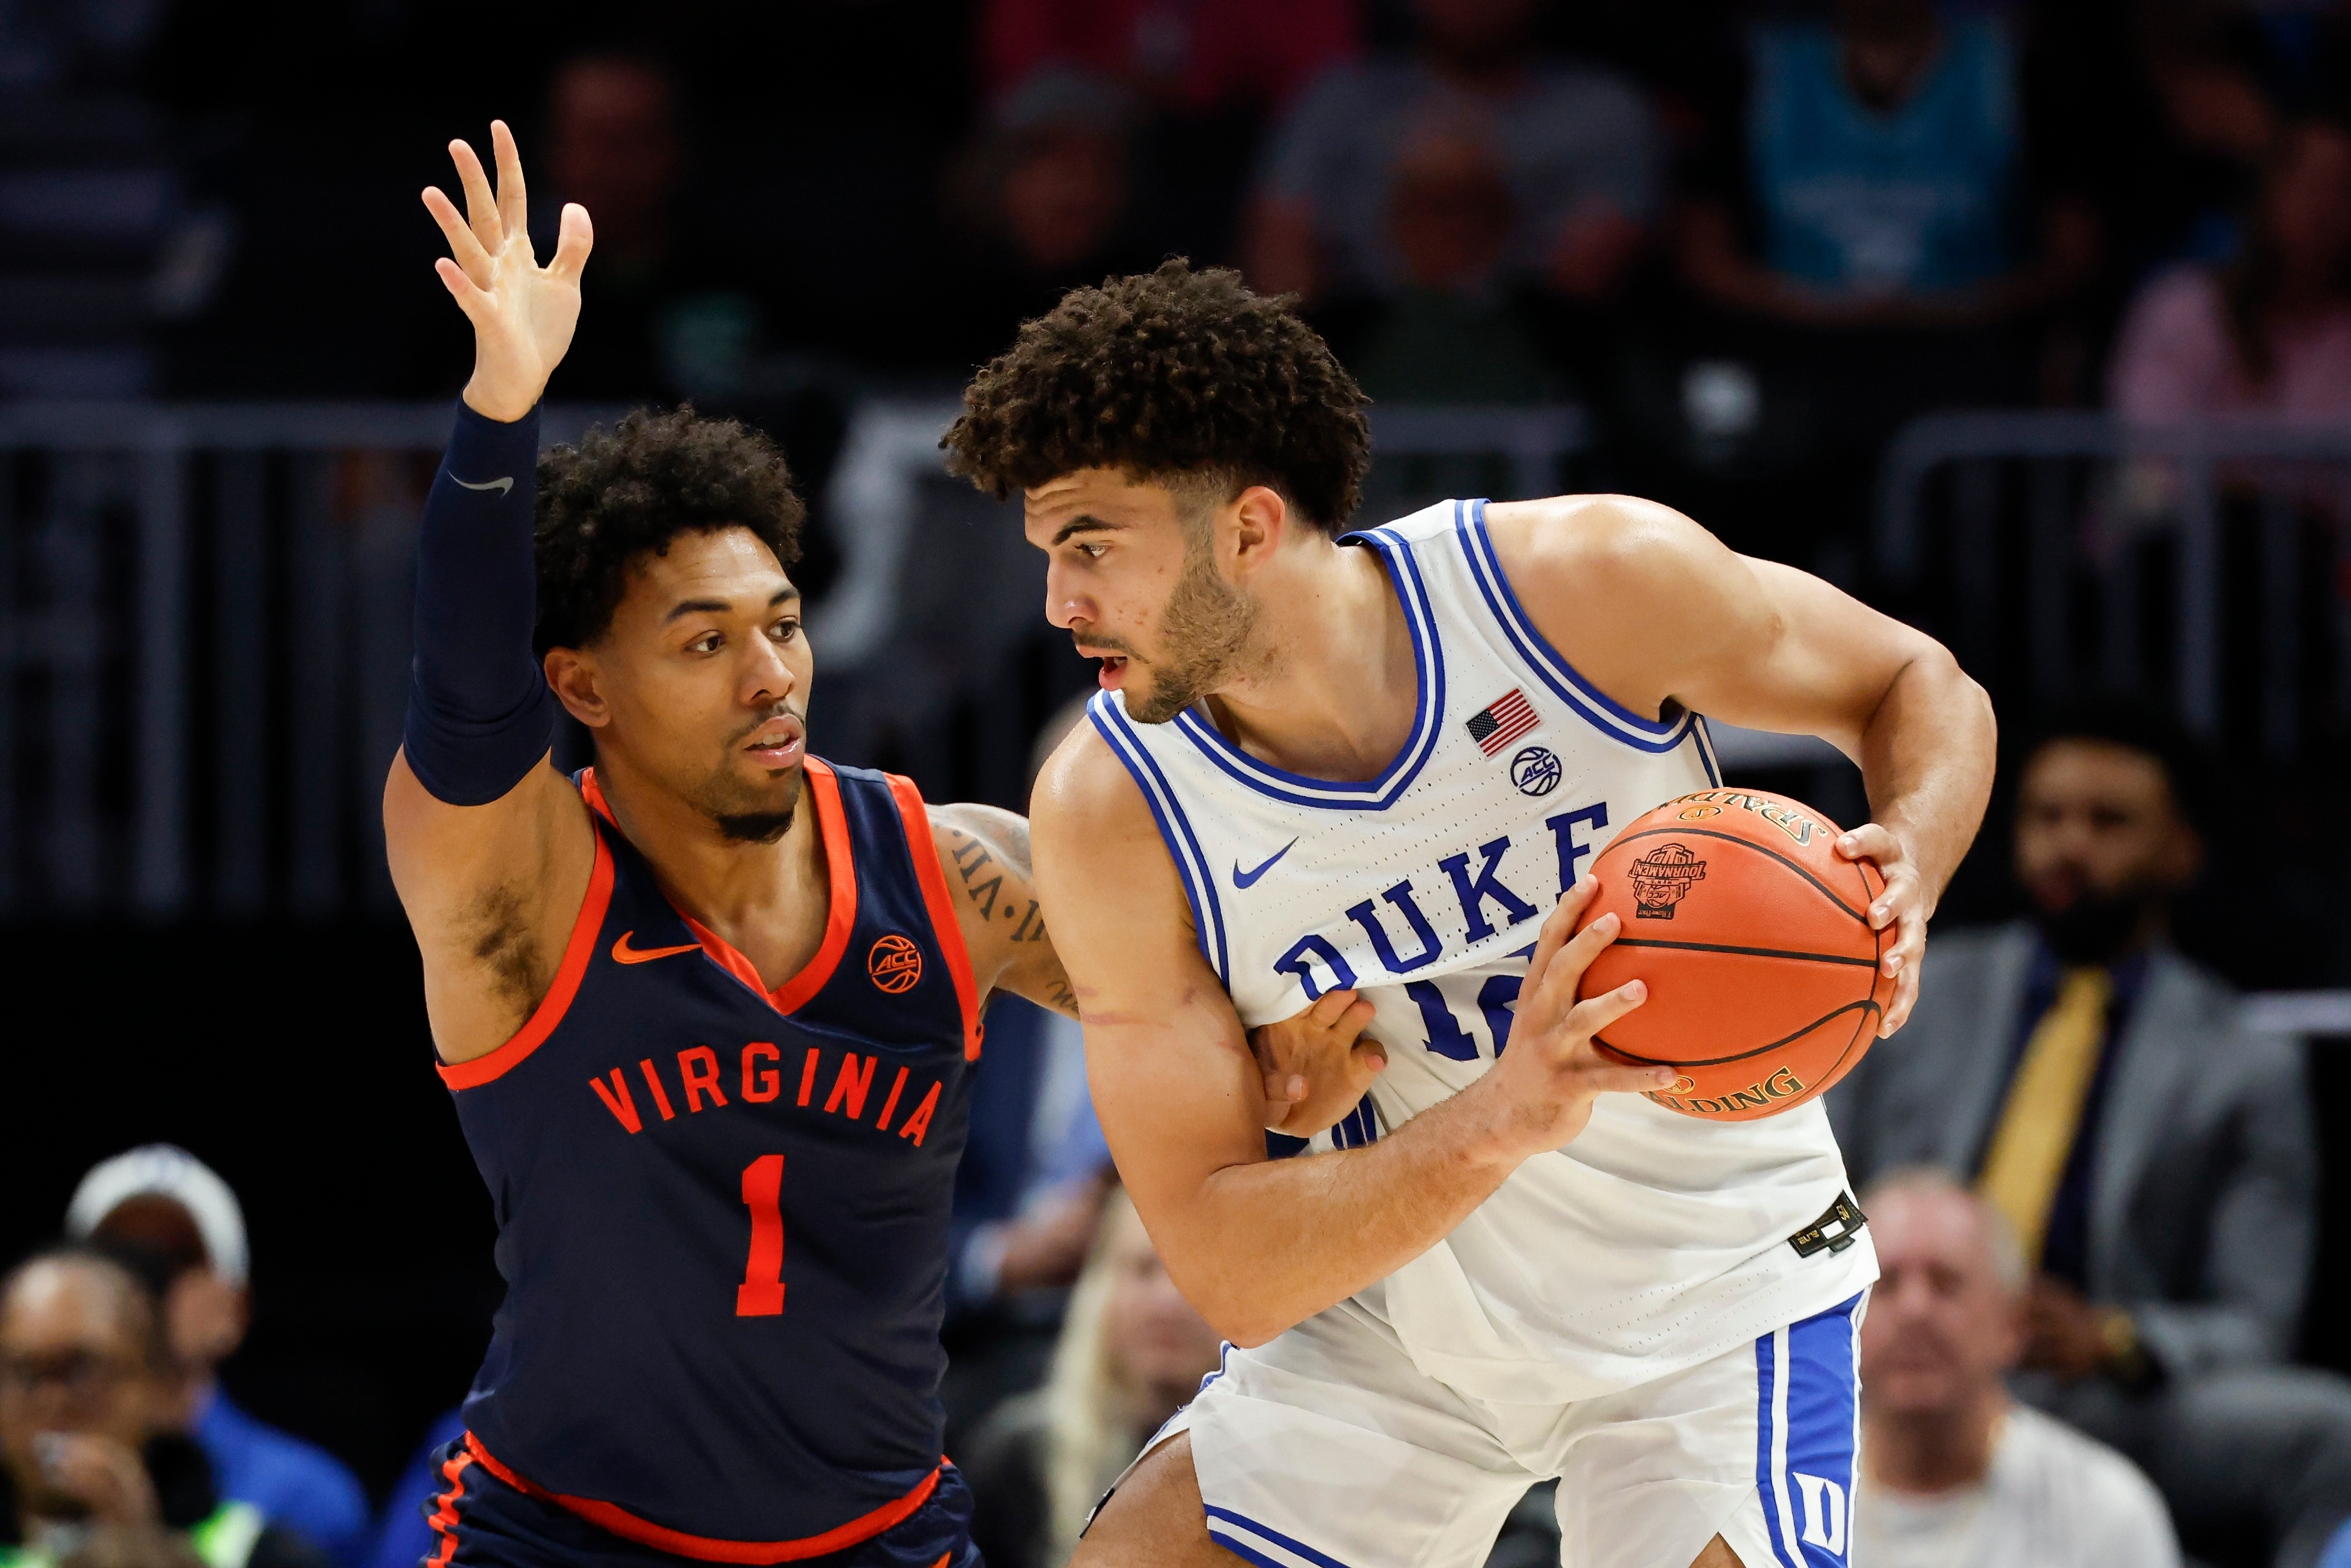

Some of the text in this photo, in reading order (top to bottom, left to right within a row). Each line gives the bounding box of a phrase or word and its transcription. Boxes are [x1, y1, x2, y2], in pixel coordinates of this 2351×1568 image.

[1521, 753, 1555, 782] ACC
[1274, 801, 1609, 1001] DUKE
[1628, 860, 1705, 879] TOURNAMENT
[876, 949, 917, 972] ACC
[589, 1042, 943, 1147] VIRGINIA
[736, 1154, 785, 1317] 1
[1791, 1471, 1846, 1557] D
